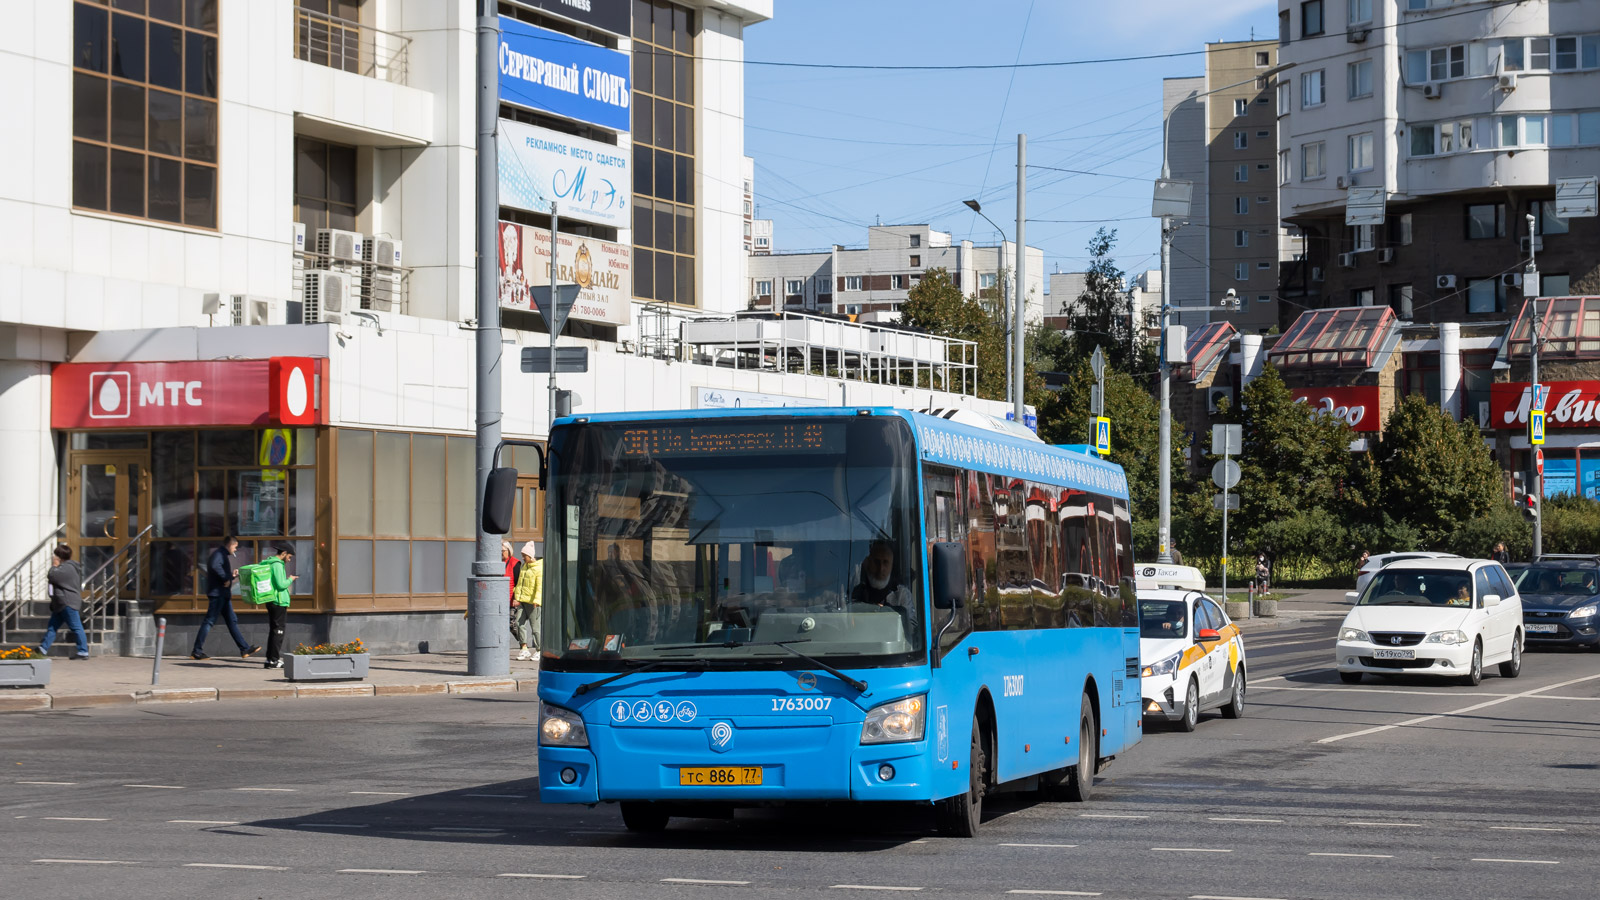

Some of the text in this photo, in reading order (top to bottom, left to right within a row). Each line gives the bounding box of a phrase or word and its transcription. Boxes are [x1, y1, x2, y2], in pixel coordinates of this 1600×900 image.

[526, 137, 626, 169] РЕКЛАМНОЕ МЕСТО СДАЕТСЯ
[597, 293, 609, 303] ЗАЛ
[139, 381, 203, 407] МТС
[1143, 567, 1154, 576] Go
[1003, 674, 1024, 697] 1763007
[771, 697, 832, 711] 1763007
[709, 769, 735, 783] 886
[743, 768, 757, 779] 77
